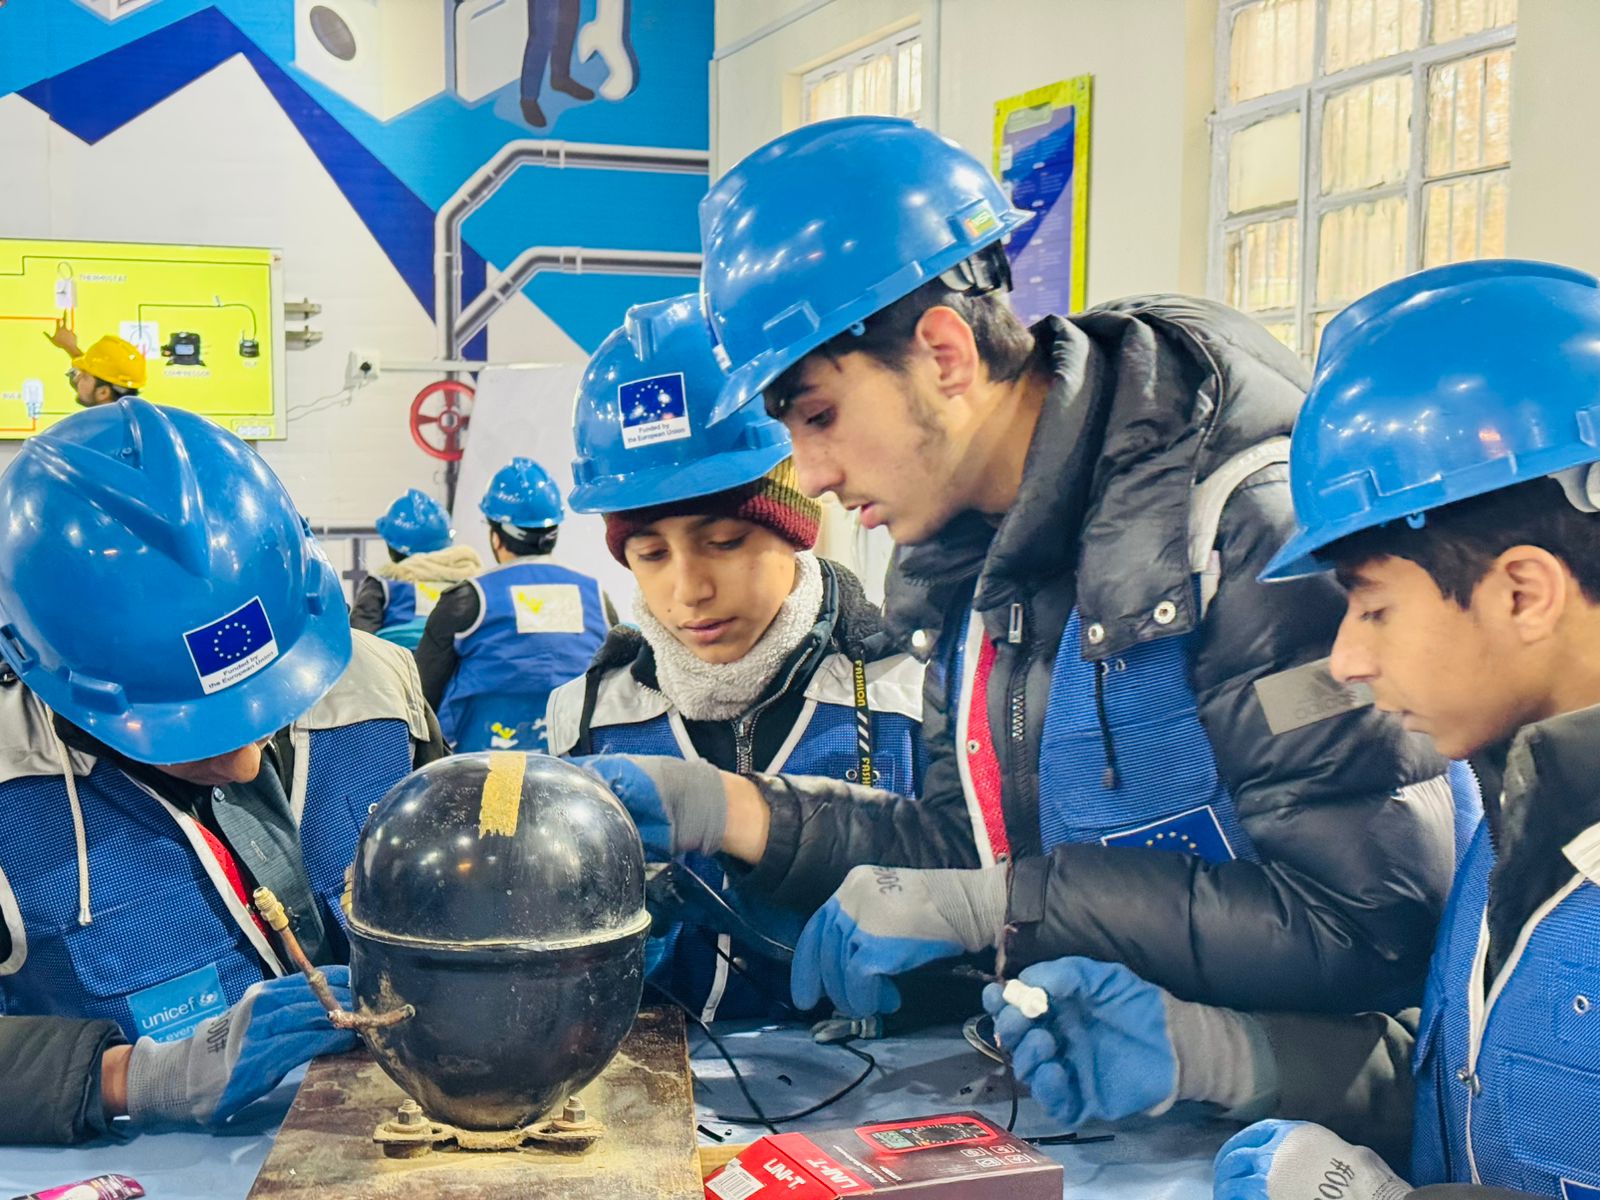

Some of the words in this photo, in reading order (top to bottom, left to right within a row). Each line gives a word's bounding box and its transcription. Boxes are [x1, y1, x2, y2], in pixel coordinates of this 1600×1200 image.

[637, 431, 666, 441] European
[667, 428, 685, 436] Union
[638, 424, 661, 433] Funded
[661, 422, 671, 430] by
[208, 681, 221, 689] the
[222, 662, 256, 684] European
[255, 651, 274, 666] Union
[223, 657, 249, 676] Funded
[250, 654, 259, 664] by
[855, 660, 866, 707] FASHION
[862, 757, 871, 786] FASH
[142, 996, 195, 1030] unicef
